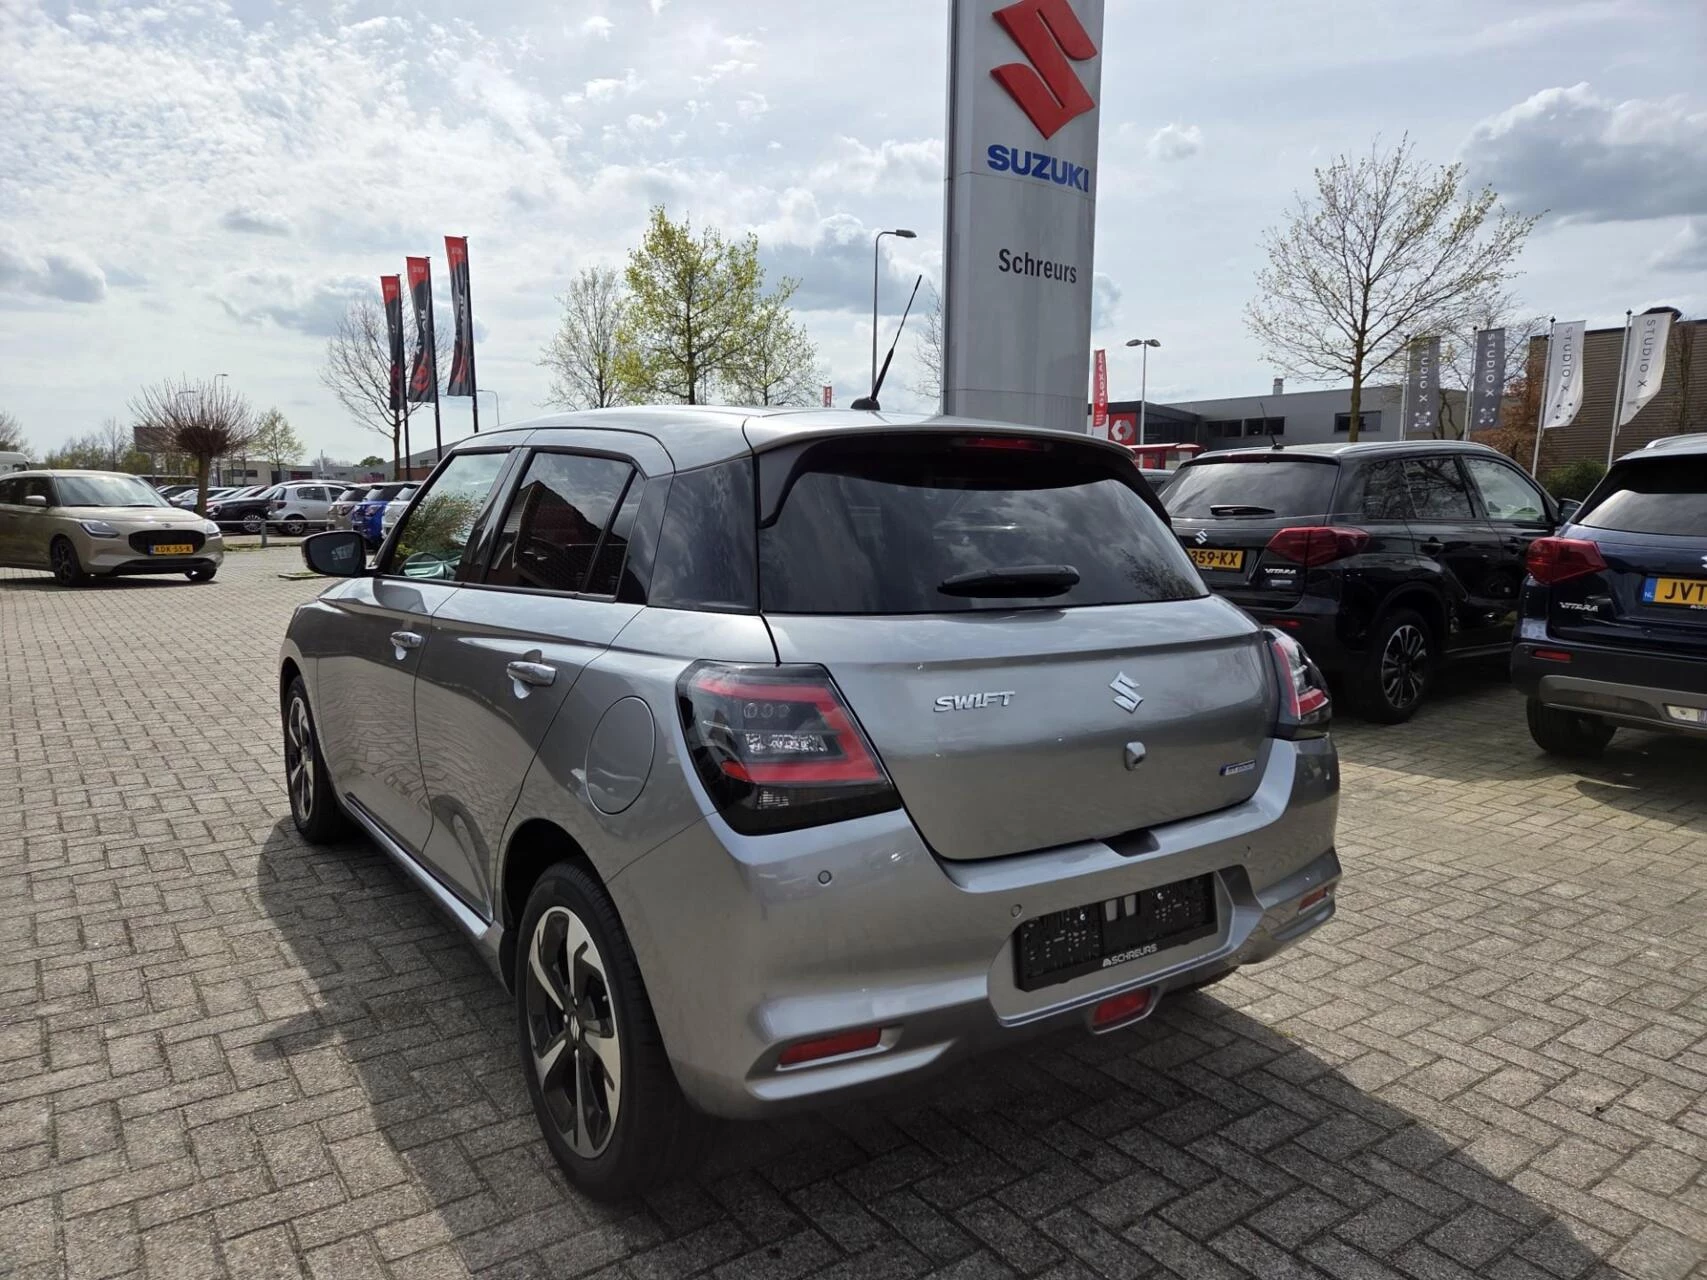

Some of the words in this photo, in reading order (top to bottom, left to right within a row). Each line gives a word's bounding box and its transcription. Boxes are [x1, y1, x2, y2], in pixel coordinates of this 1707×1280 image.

[987, 144, 1089, 192] SUZUKI
[998, 249, 1077, 283] Schreurs
[1562, 326, 1573, 378] STUDIO
[1640, 319, 1656, 373] STUDIO
[1420, 348, 1430, 389] TUDIO
[1486, 333, 1496, 383] STUDIO
[1485, 389, 1494, 397] X
[1560, 384, 1570, 392] X
[1637, 380, 1649, 388] X
[1419, 394, 1428, 402] X
[1664, 581, 1707, 602] JVT
[1560, 601, 1599, 612] VITARA
[933, 690, 1016, 712] SWIFT
[1111, 943, 1158, 965] SCHREURS
